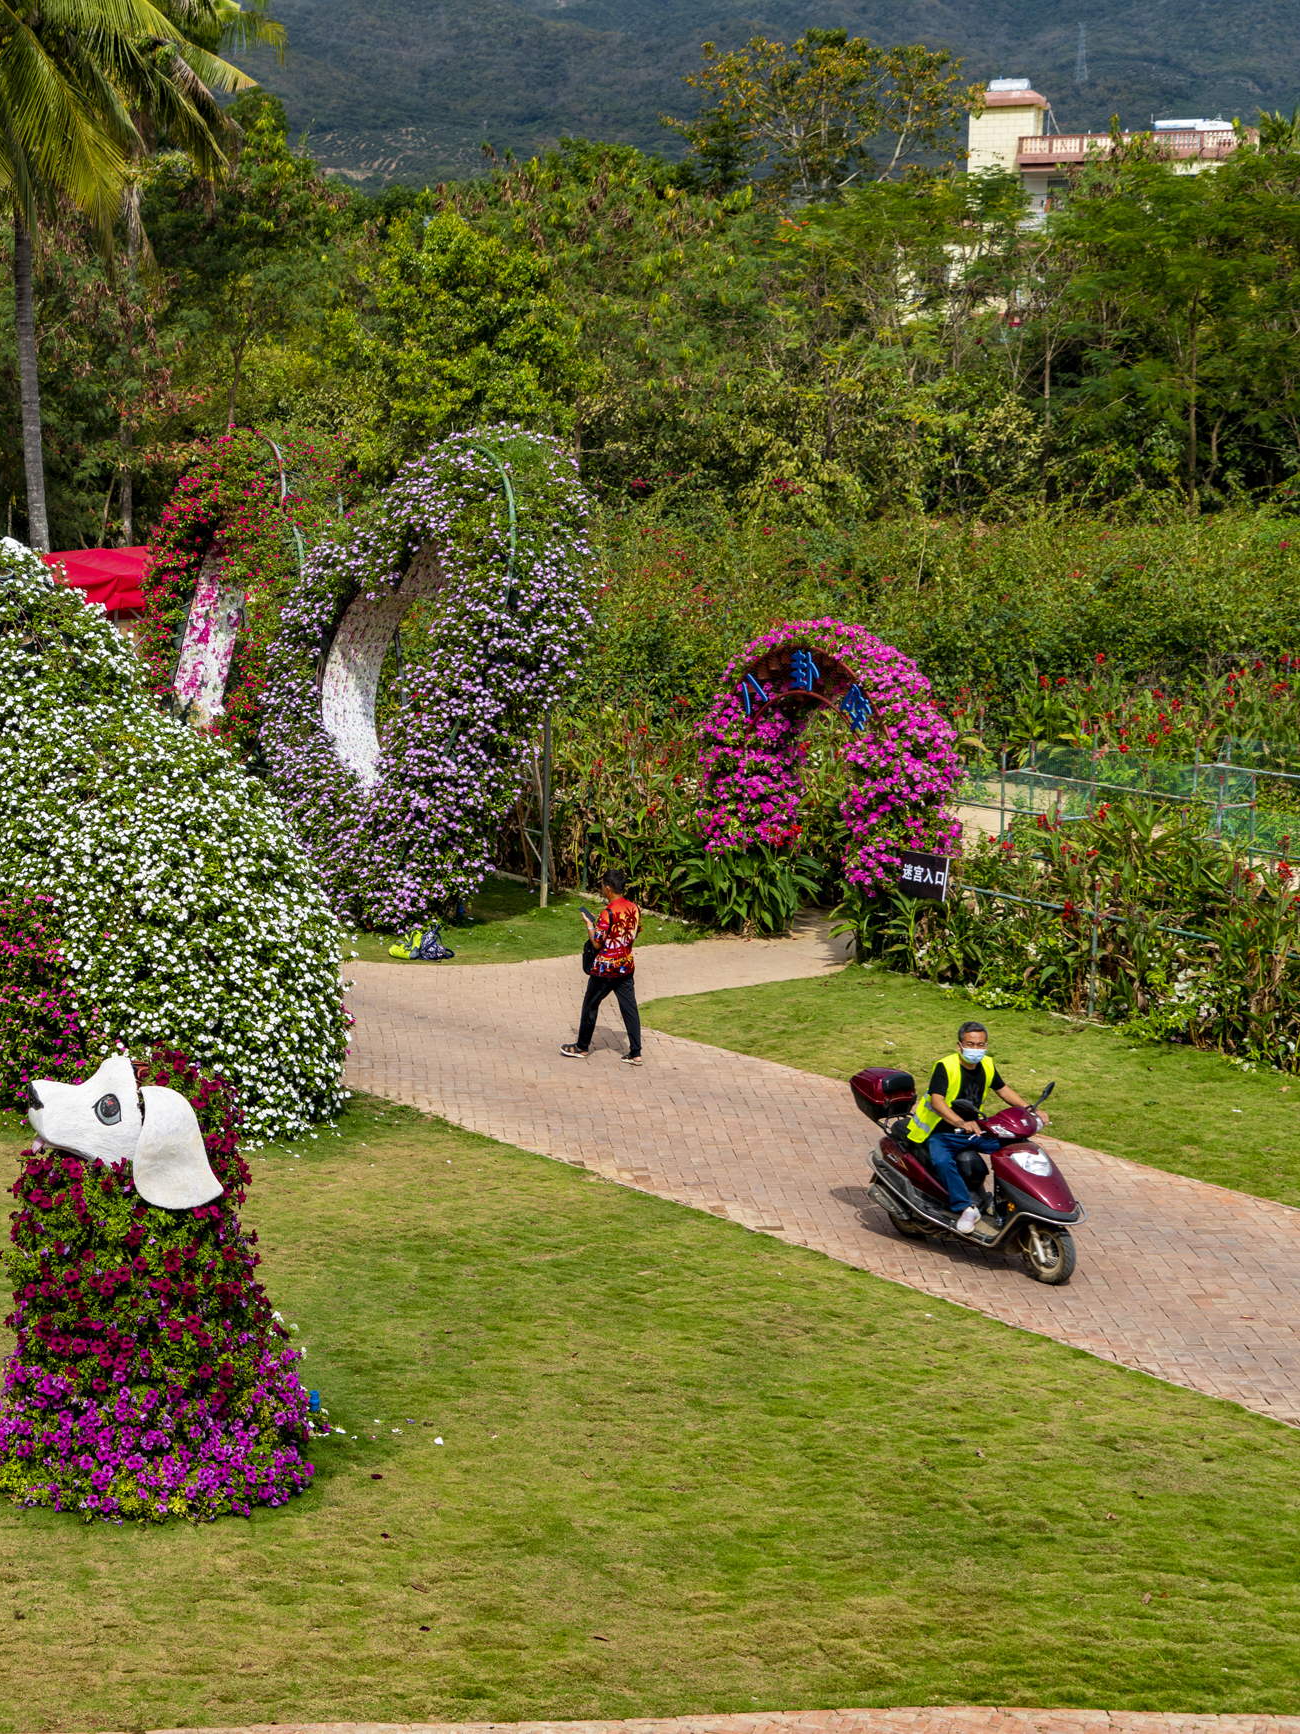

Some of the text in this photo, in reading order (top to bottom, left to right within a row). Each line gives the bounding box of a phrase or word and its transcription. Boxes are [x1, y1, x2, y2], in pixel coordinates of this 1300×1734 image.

[742, 650, 872, 731] 八卦阵
[902, 863, 945, 886] 迷宫入口
